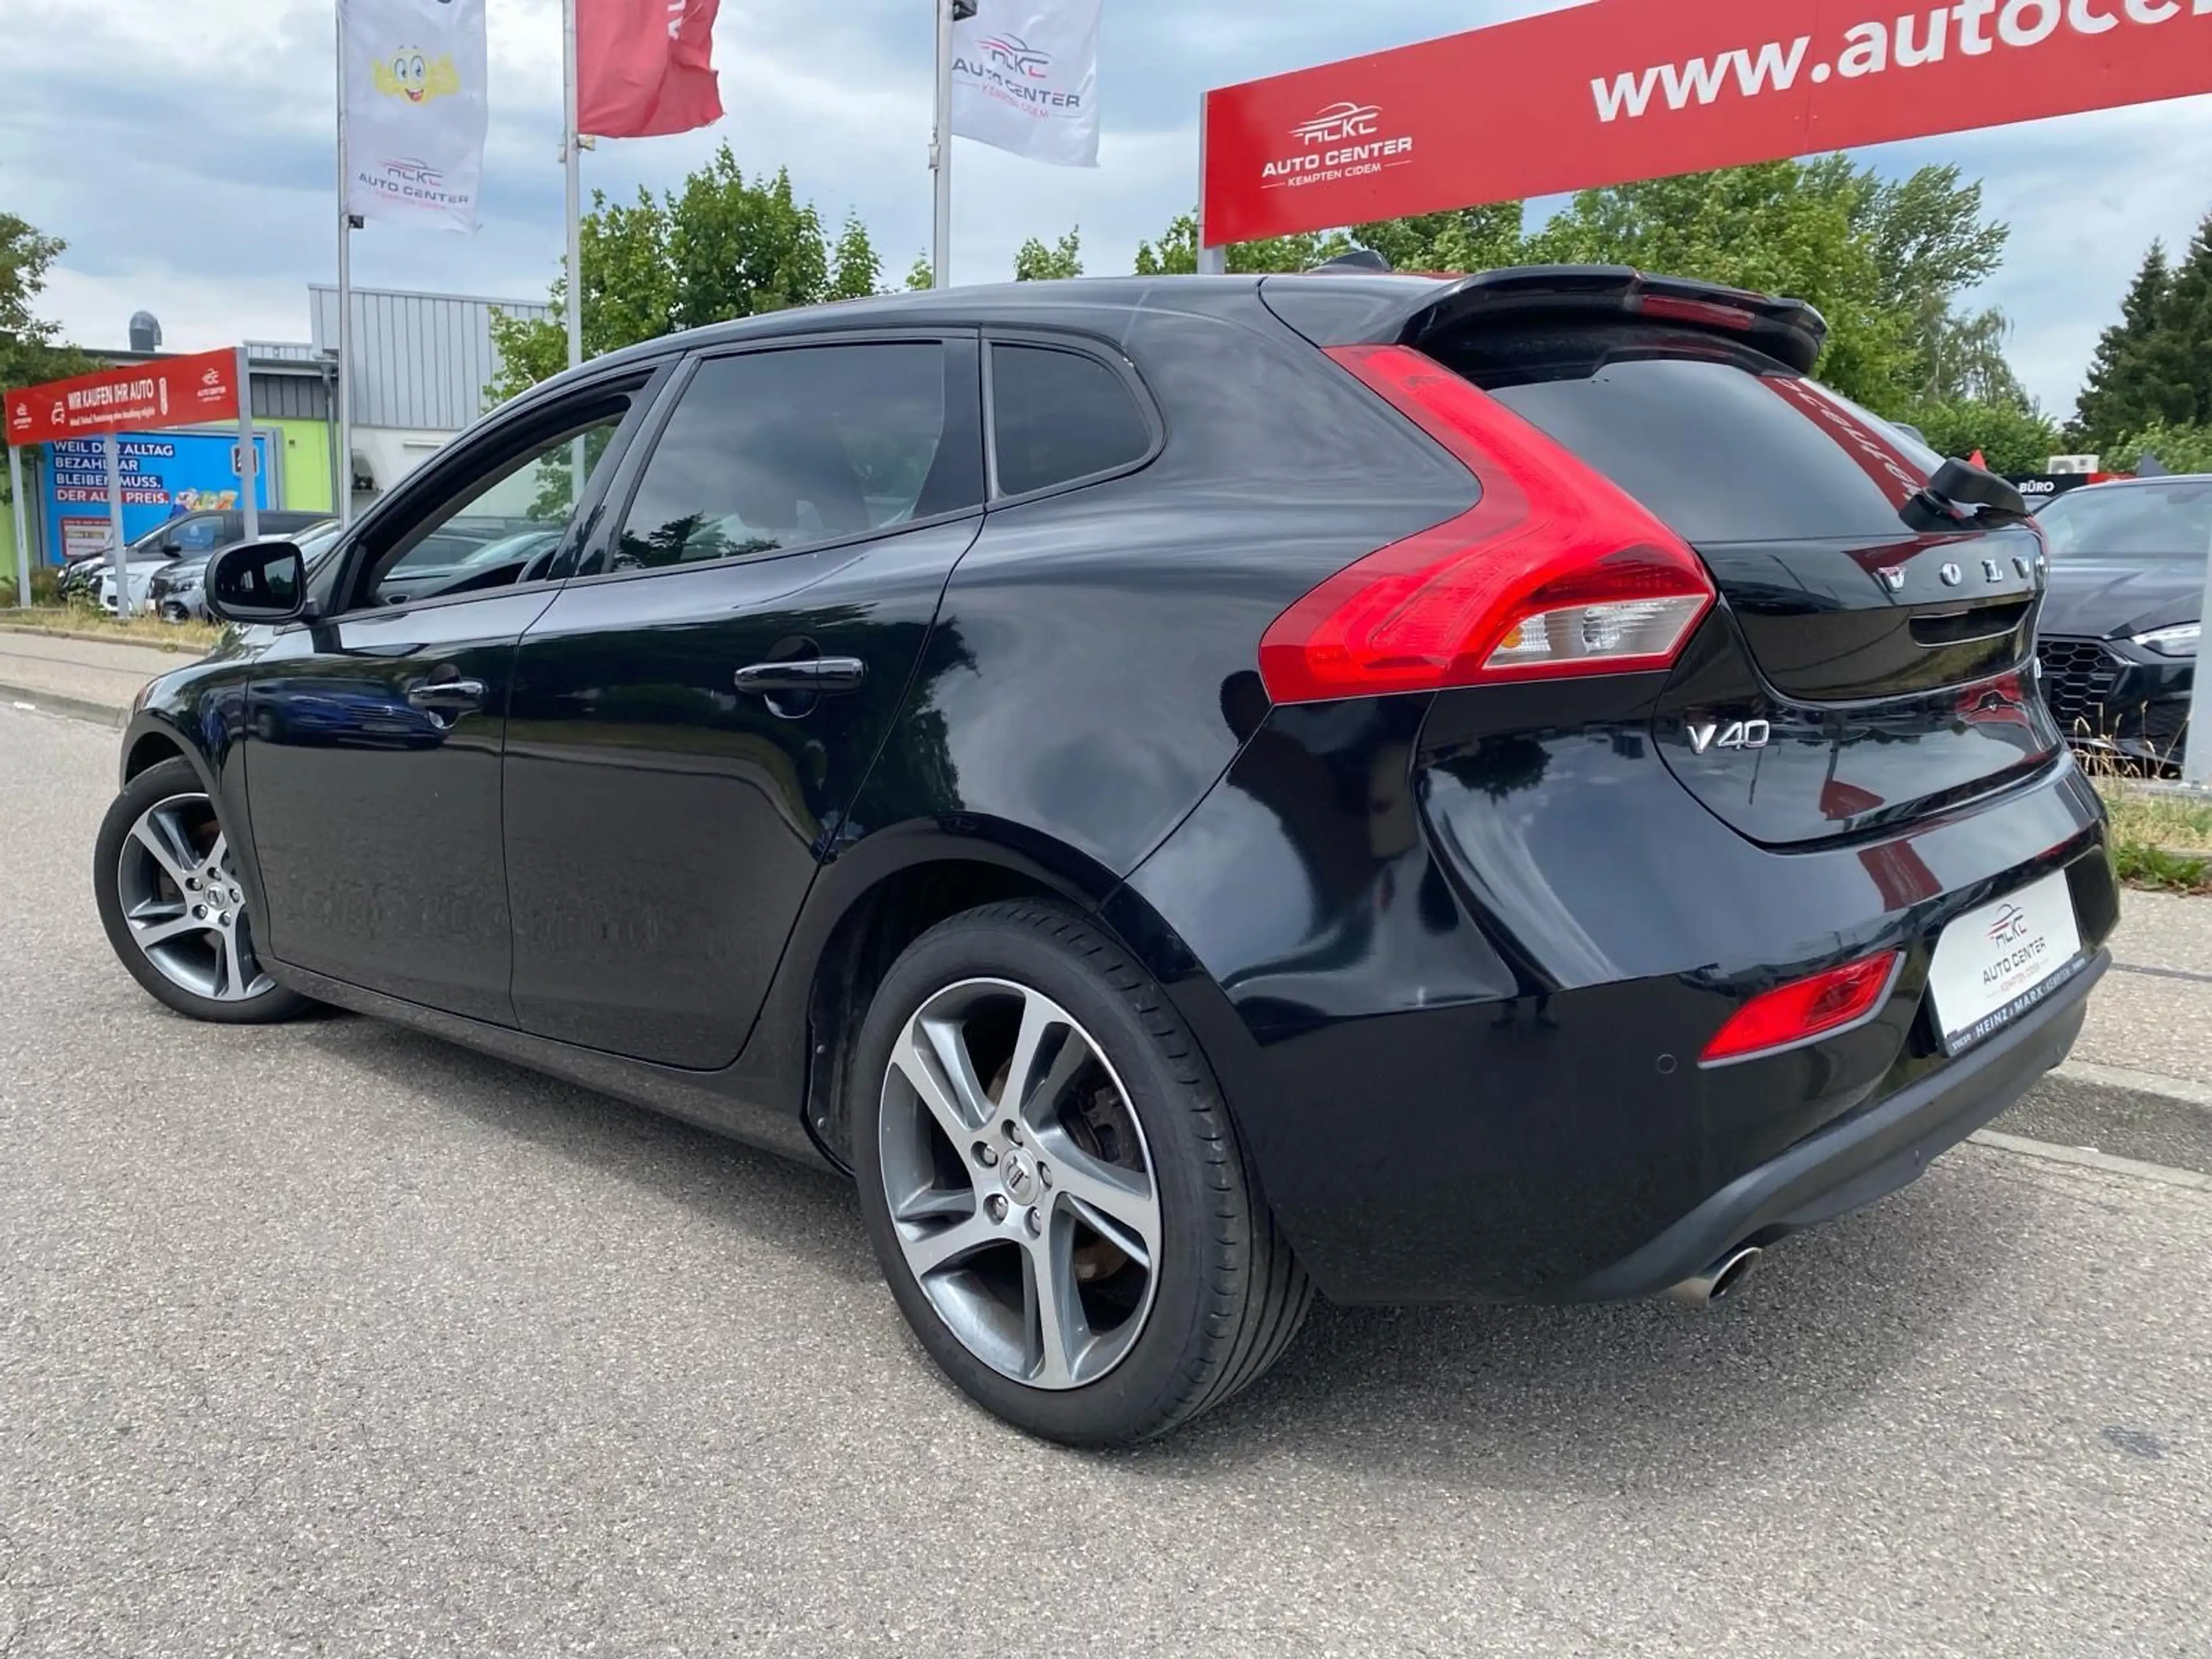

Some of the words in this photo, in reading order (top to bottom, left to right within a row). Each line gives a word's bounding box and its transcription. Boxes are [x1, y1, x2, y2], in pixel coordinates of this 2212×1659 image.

[1590, 0, 2212, 122] www.autoc
[1262, 154, 1320, 177] AUTO
[1325, 137, 1413, 166] CENTER
[359, 172, 399, 192] AUTO
[403, 185, 469, 203] CENTER
[1287, 169, 1342, 187] KEMPTEN
[1344, 163, 1382, 177] CIDEM
[82, 385, 113, 408] KAUFEN
[130, 378, 154, 400] AUTO
[54, 441, 89, 453] WEIL
[124, 444, 173, 456] ALLTAG
[57, 490, 86, 501] DER
[126, 493, 169, 504] PREIS.
[120, 476, 161, 488] MUSS.
[2018, 480, 2055, 493] BÜRO
[1685, 719, 1770, 754] V40
[1983, 957, 2012, 984] AUTO
[2012, 936, 2046, 967] CENTER
[1975, 1007, 2009, 1037] HEINZ
[2014, 987, 2044, 1013] MARX
